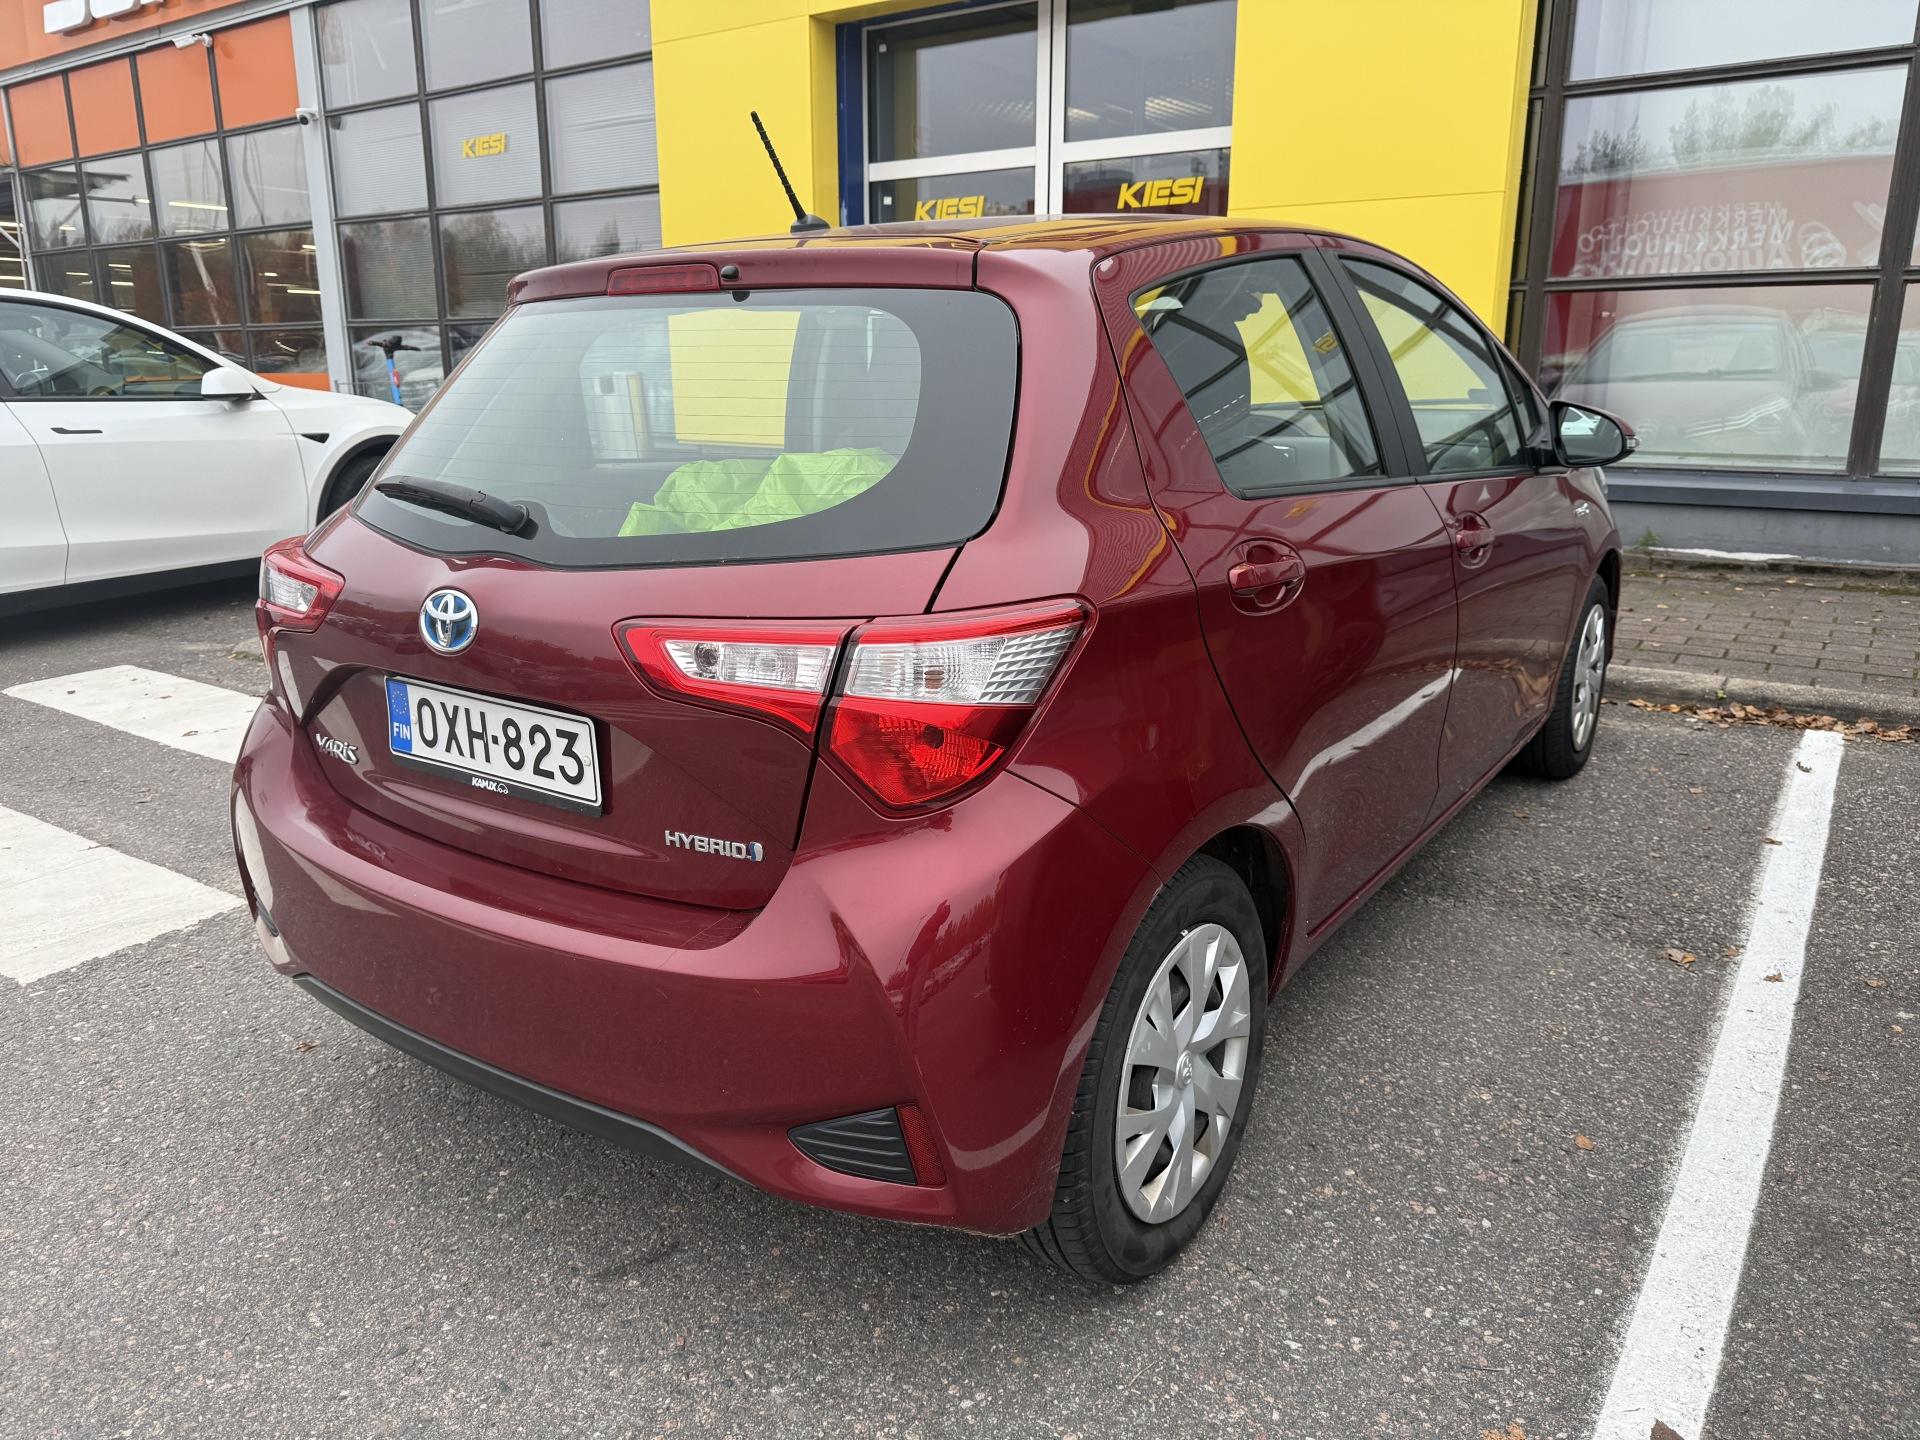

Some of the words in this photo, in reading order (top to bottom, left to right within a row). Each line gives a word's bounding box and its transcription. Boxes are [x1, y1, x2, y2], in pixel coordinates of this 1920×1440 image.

[463, 131, 506, 159] KIESI
[1117, 176, 1204, 210] KIESI
[914, 195, 985, 221] KIESI
[393, 721, 411, 740] FIN
[416, 697, 585, 785] OXH-823
[471, 776, 498, 792] KAMUX
[664, 830, 747, 859] HYBRID
